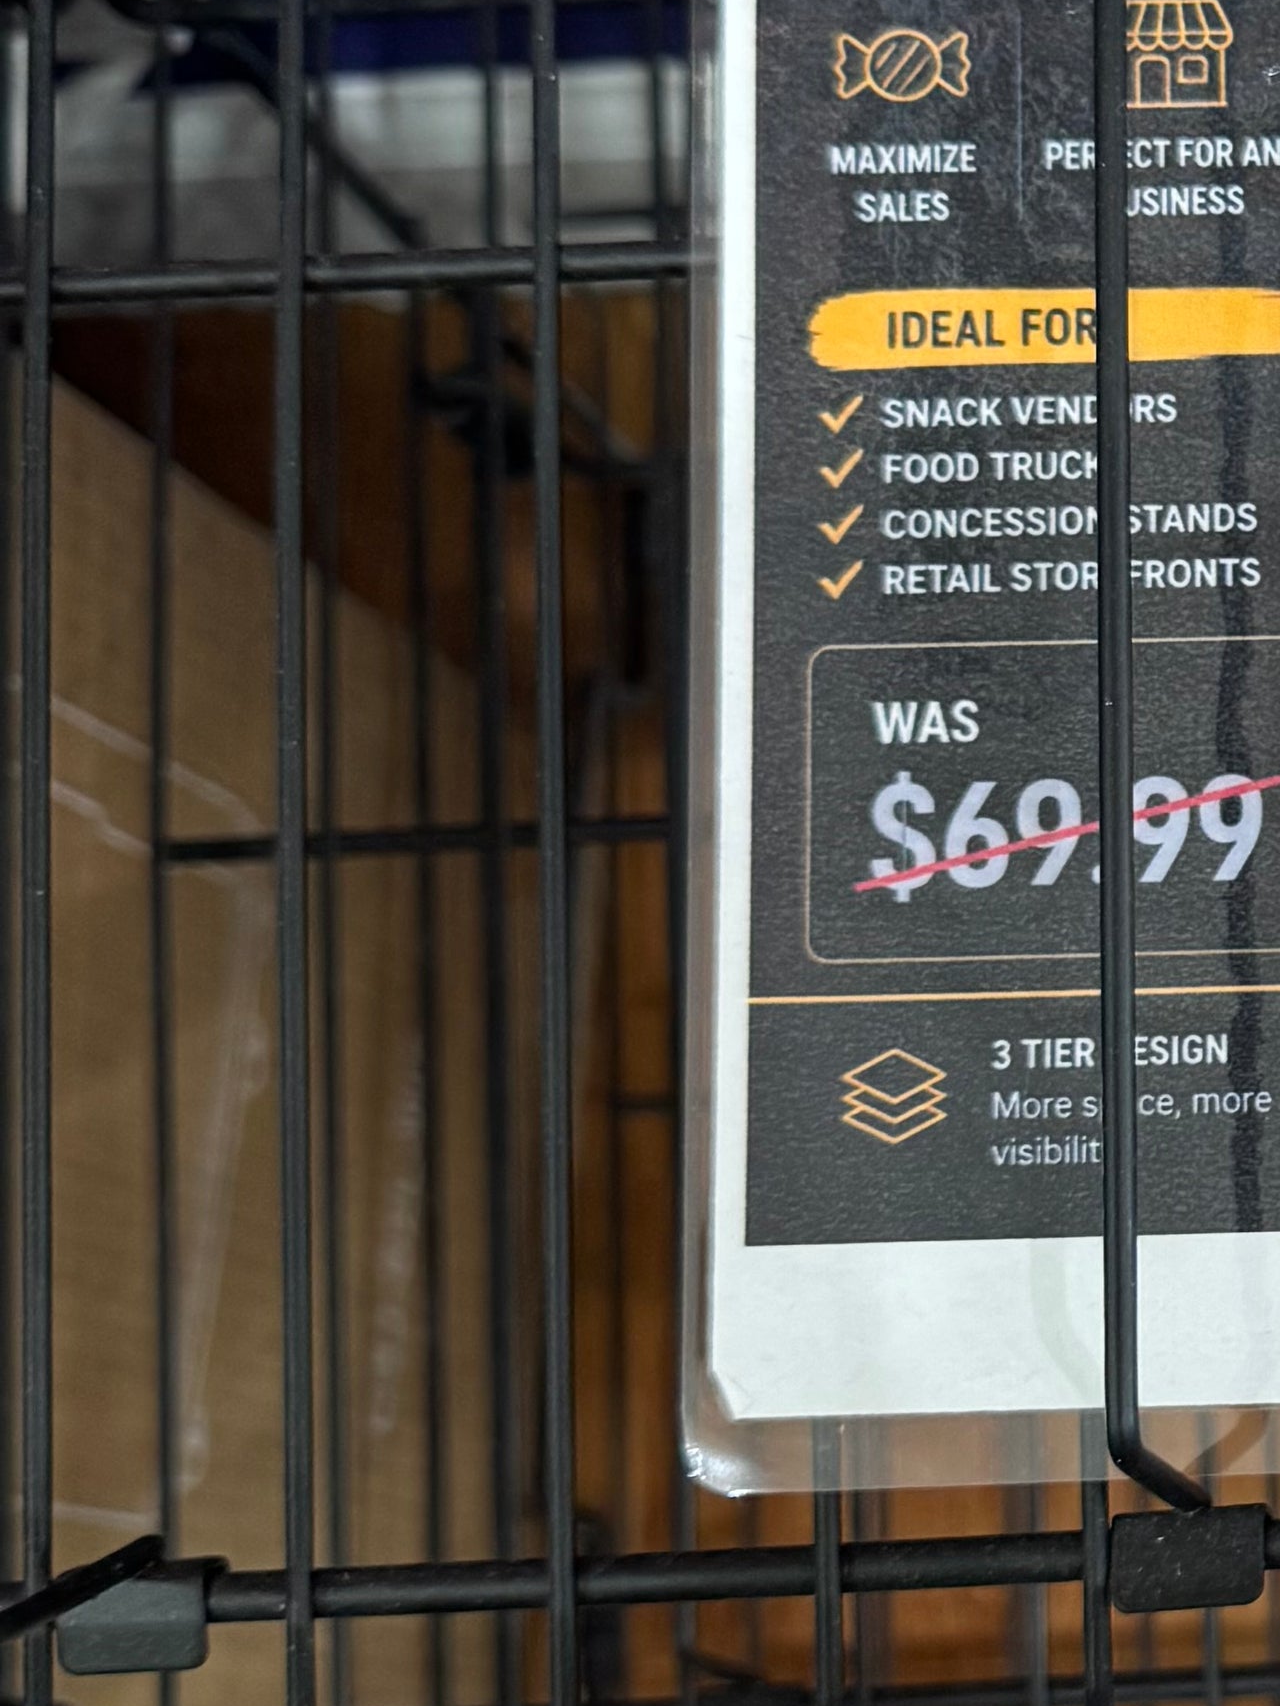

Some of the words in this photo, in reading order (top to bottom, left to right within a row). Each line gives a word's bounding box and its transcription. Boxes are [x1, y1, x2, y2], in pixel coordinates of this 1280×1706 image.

[829, 142, 977, 175] MAXIMIZE
[1044, 138, 1171, 170] PERCT
[1178, 137, 1233, 168] FOR
[855, 192, 950, 223] SALES
[1126, 185, 1245, 217] USINESS
[888, 310, 1005, 349] IDEAL
[1021, 308, 1097, 347] FOR
[881, 397, 1002, 428] SNACK
[1011, 394, 1177, 425] VENDRS
[883, 454, 979, 483] FOOD
[990, 451, 1097, 481] TRUCK
[1129, 502, 1258, 534] STANDS
[883, 563, 1001, 594] RETAIL
[1010, 557, 1261, 592] STORFRONTS
[874, 700, 980, 744] WAS
[991, 1040, 1011, 1069] 3
[1020, 1038, 1096, 1068] TIER
[1134, 1033, 1229, 1065] ESIGN
[991, 1091, 1072, 1119] More
[1082, 1093, 1181, 1119] sce,
[1192, 1091, 1272, 1114] more
[991, 1135, 1101, 1166] visibilit
